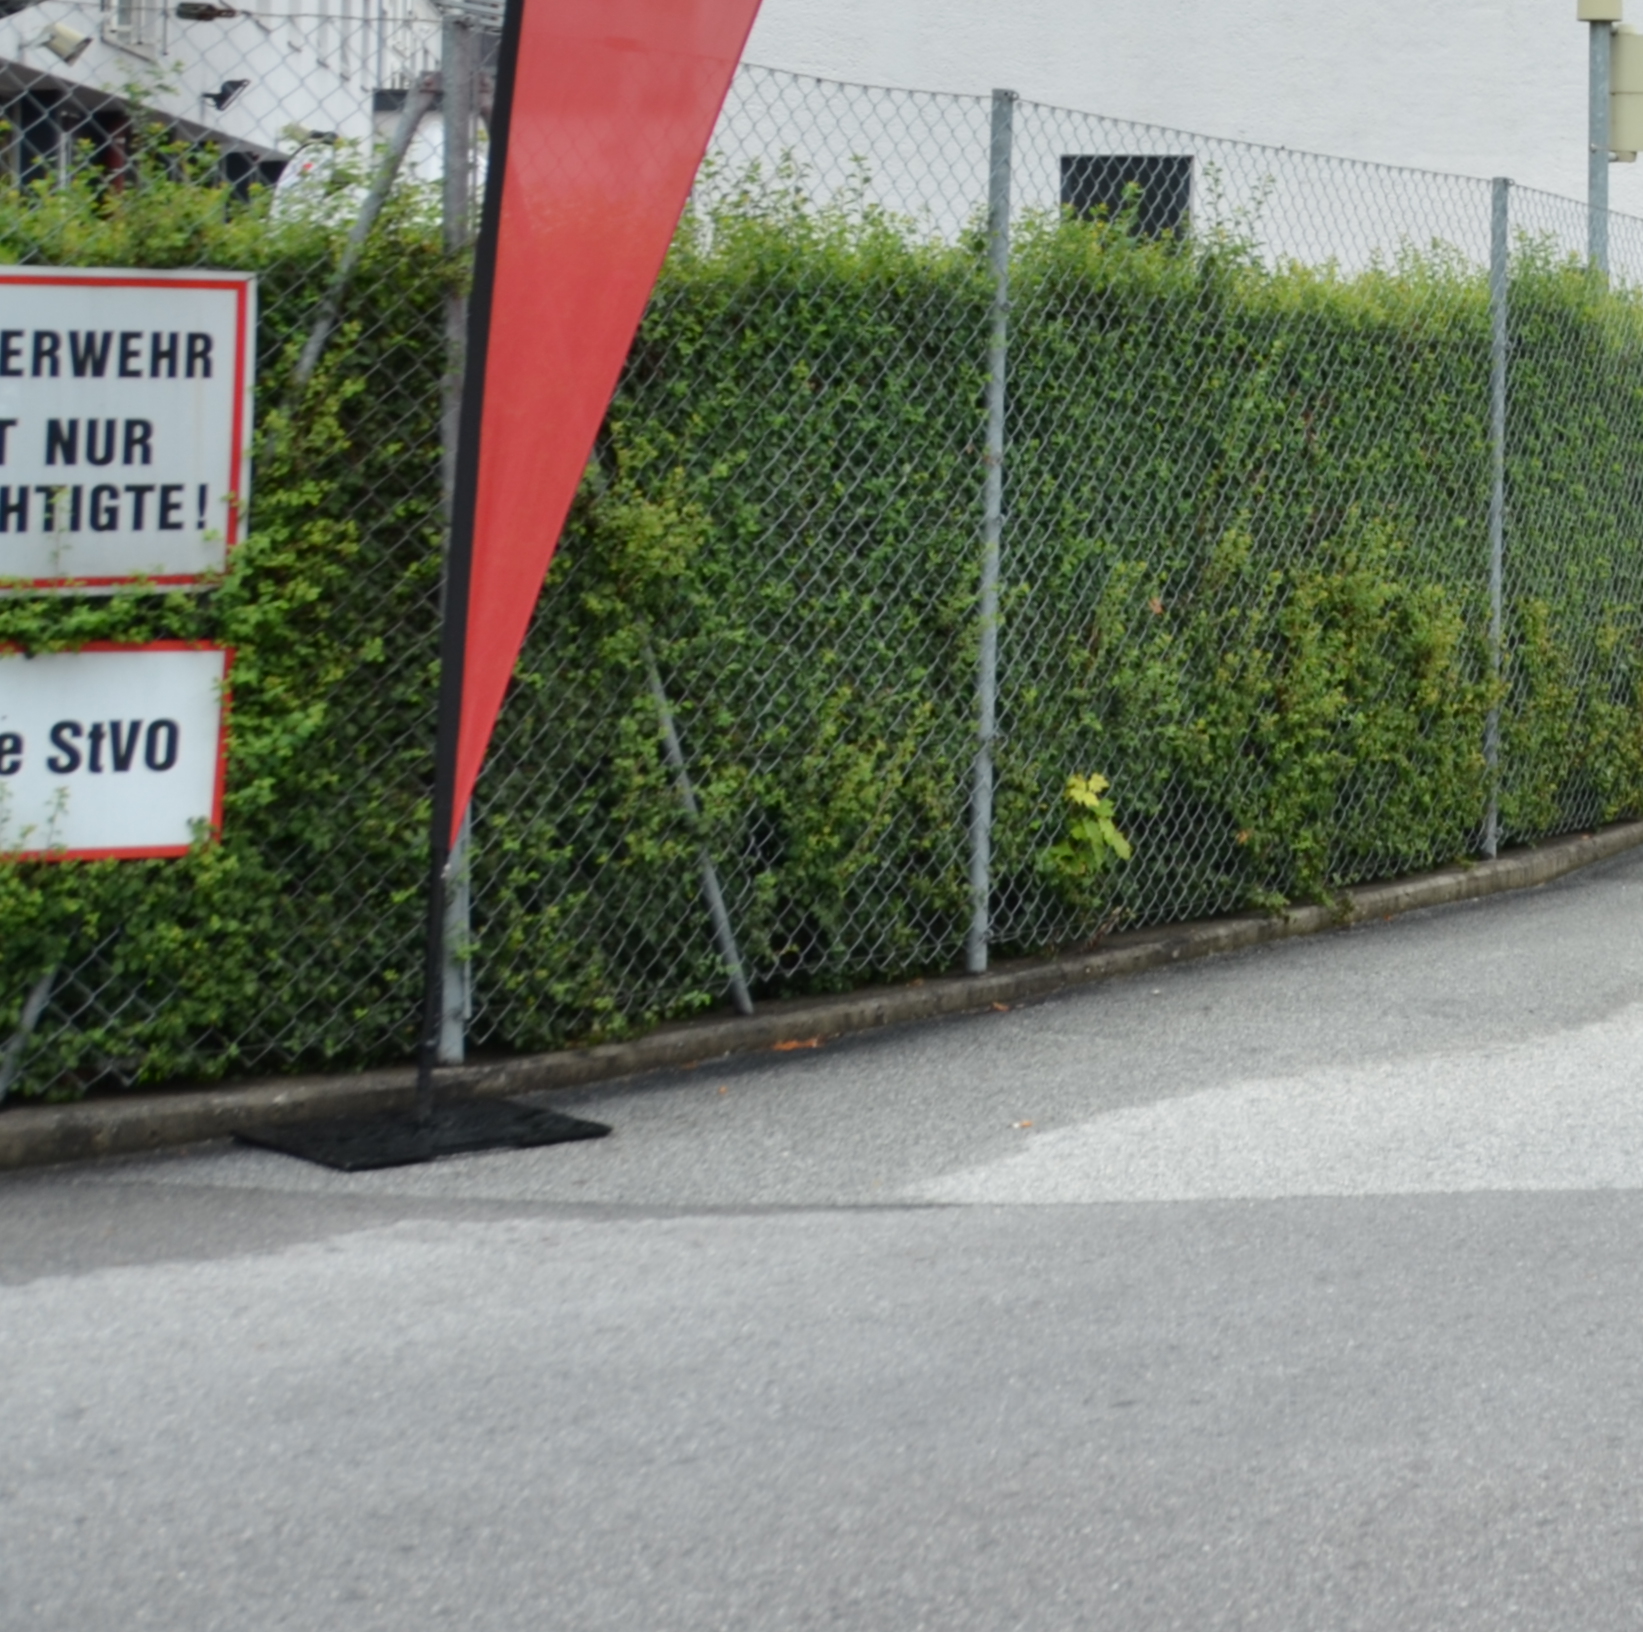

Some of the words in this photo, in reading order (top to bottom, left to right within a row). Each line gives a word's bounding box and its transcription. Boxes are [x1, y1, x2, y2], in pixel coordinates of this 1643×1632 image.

[0, 329, 213, 378] ERWEHR
[44, 418, 154, 467] NUR
[0, 482, 209, 533] HTIGTE!
[46, 718, 180, 775] StVO
